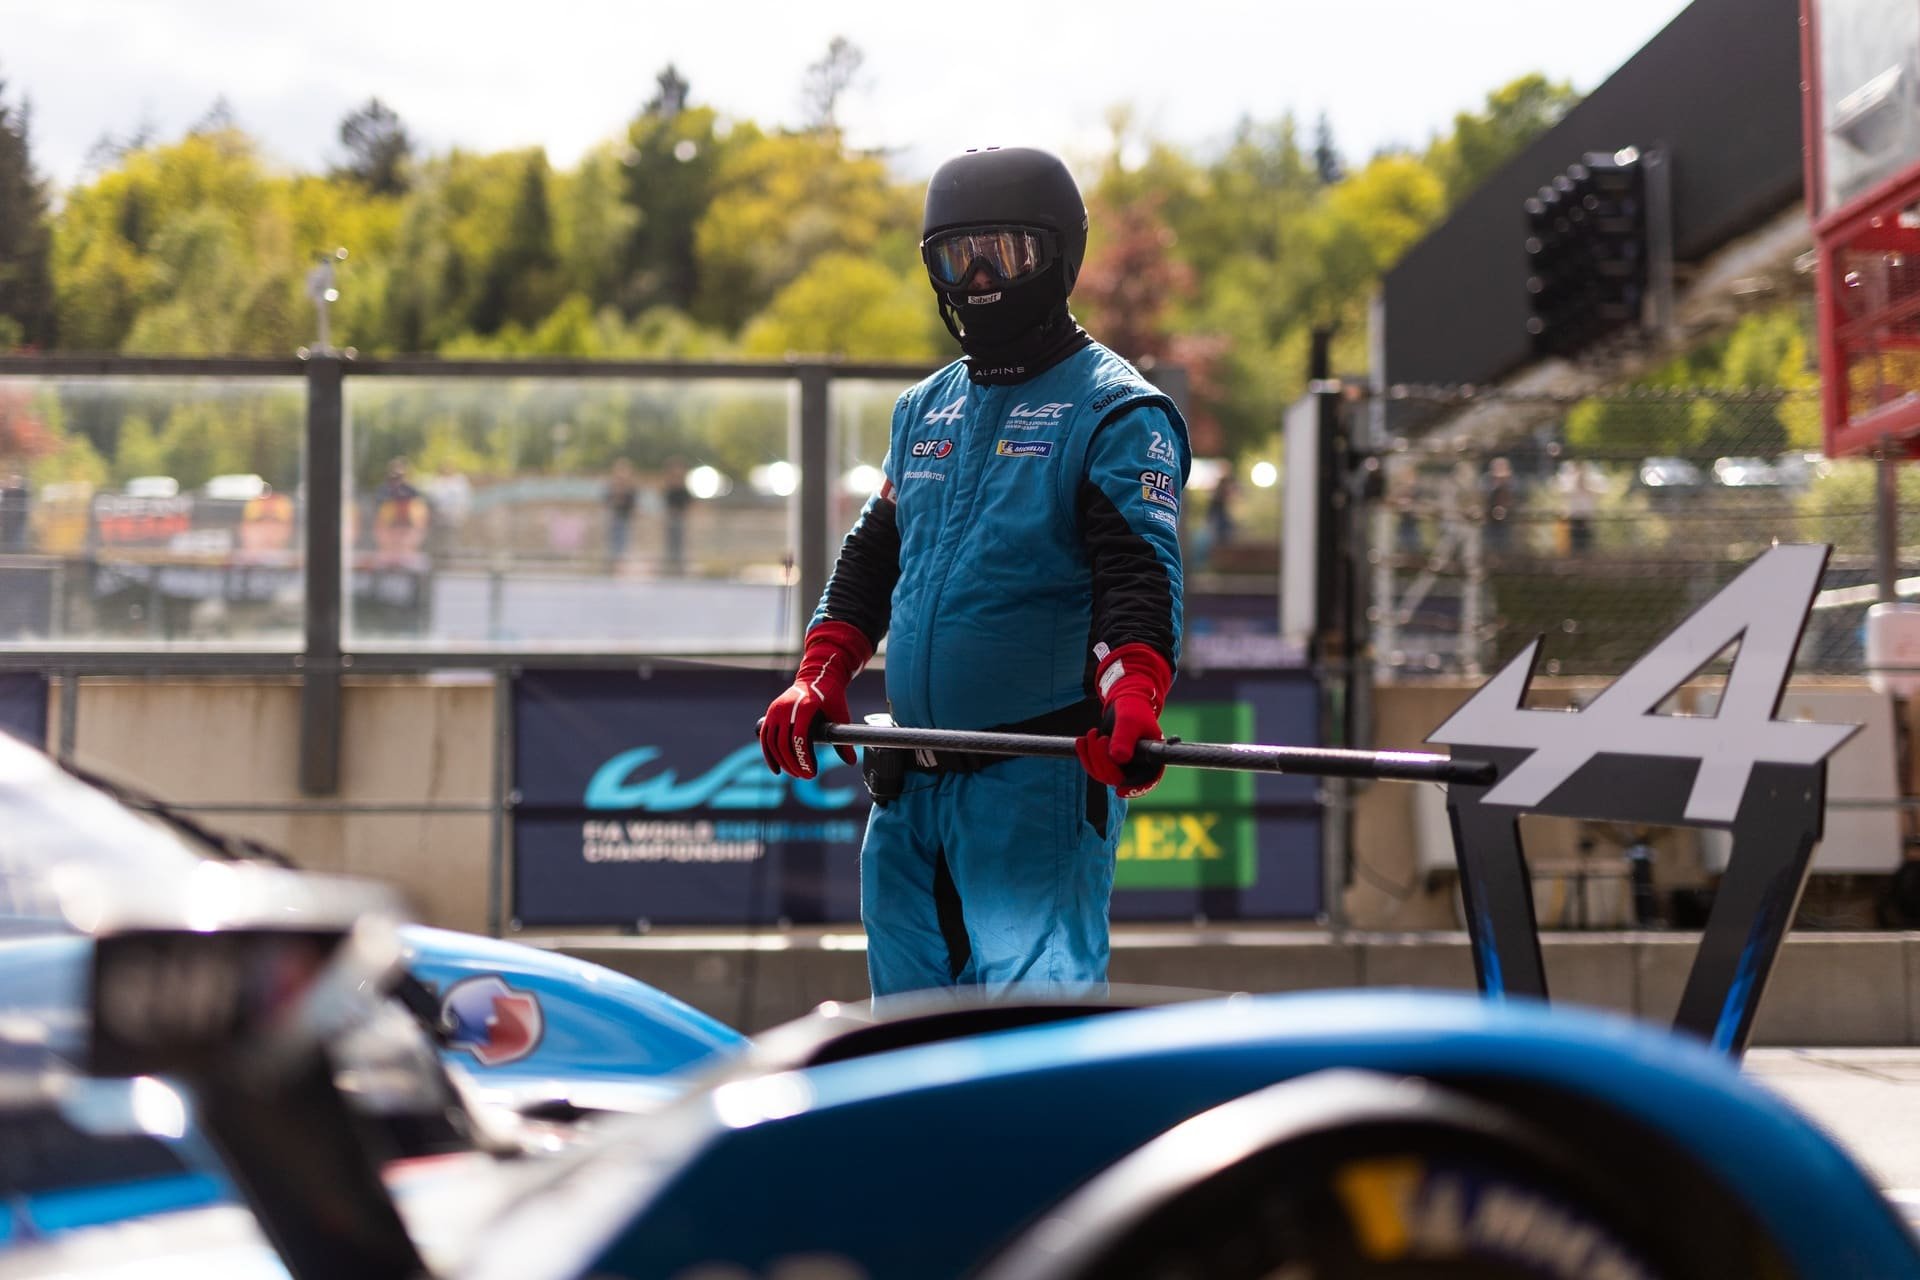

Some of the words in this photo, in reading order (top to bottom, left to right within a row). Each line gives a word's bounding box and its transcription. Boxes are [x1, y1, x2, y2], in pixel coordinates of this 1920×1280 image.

[975, 366, 1025, 377] ALPINE
[1092, 384, 1134, 414] Sabelt
[1009, 402, 1074, 418] WEC
[912, 440, 938, 456] elf
[1140, 471, 1170, 490] elf
[794, 735, 812, 773] Sabelt
[584, 741, 862, 811] WEC
[626, 820, 715, 841] WORLD
[582, 841, 766, 863] CHAMPIONSHIP
